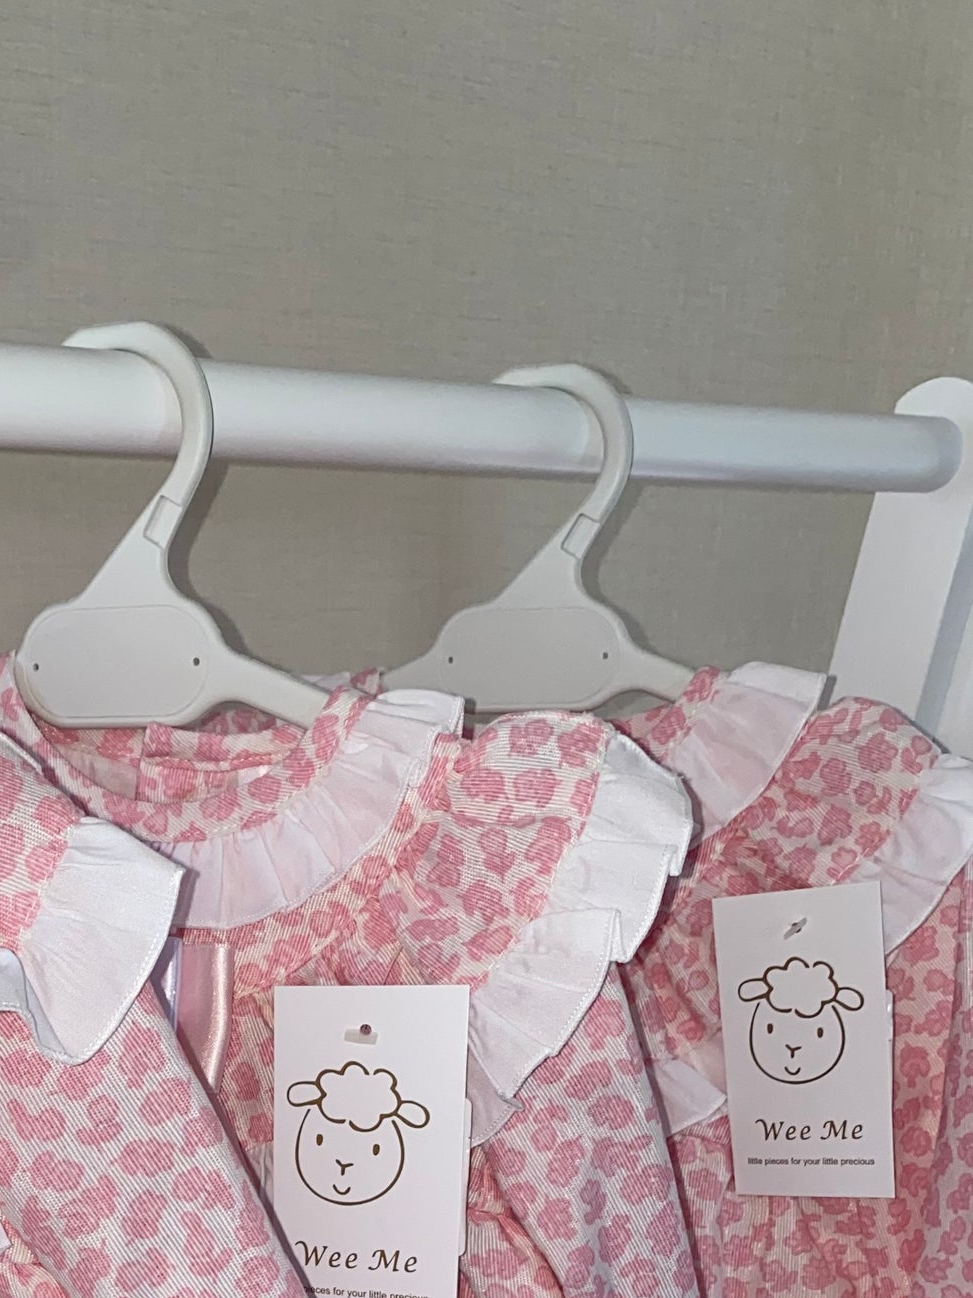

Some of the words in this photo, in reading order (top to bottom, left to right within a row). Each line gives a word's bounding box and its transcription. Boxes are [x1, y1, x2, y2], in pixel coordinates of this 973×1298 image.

[755, 1119, 811, 1141] Wee
[820, 1119, 864, 1140] Me
[748, 1157, 763, 1165] little
[764, 1157, 789, 1167] pieces
[791, 1157, 801, 1165] for
[803, 1158, 821, 1167] your
[822, 1157, 839, 1165] little
[840, 1157, 875, 1167] precious
[294, 1240, 358, 1269] Wee
[368, 1249, 418, 1273] Me
[333, 1286, 345, 1296] for
[347, 1289, 367, 1298] your
